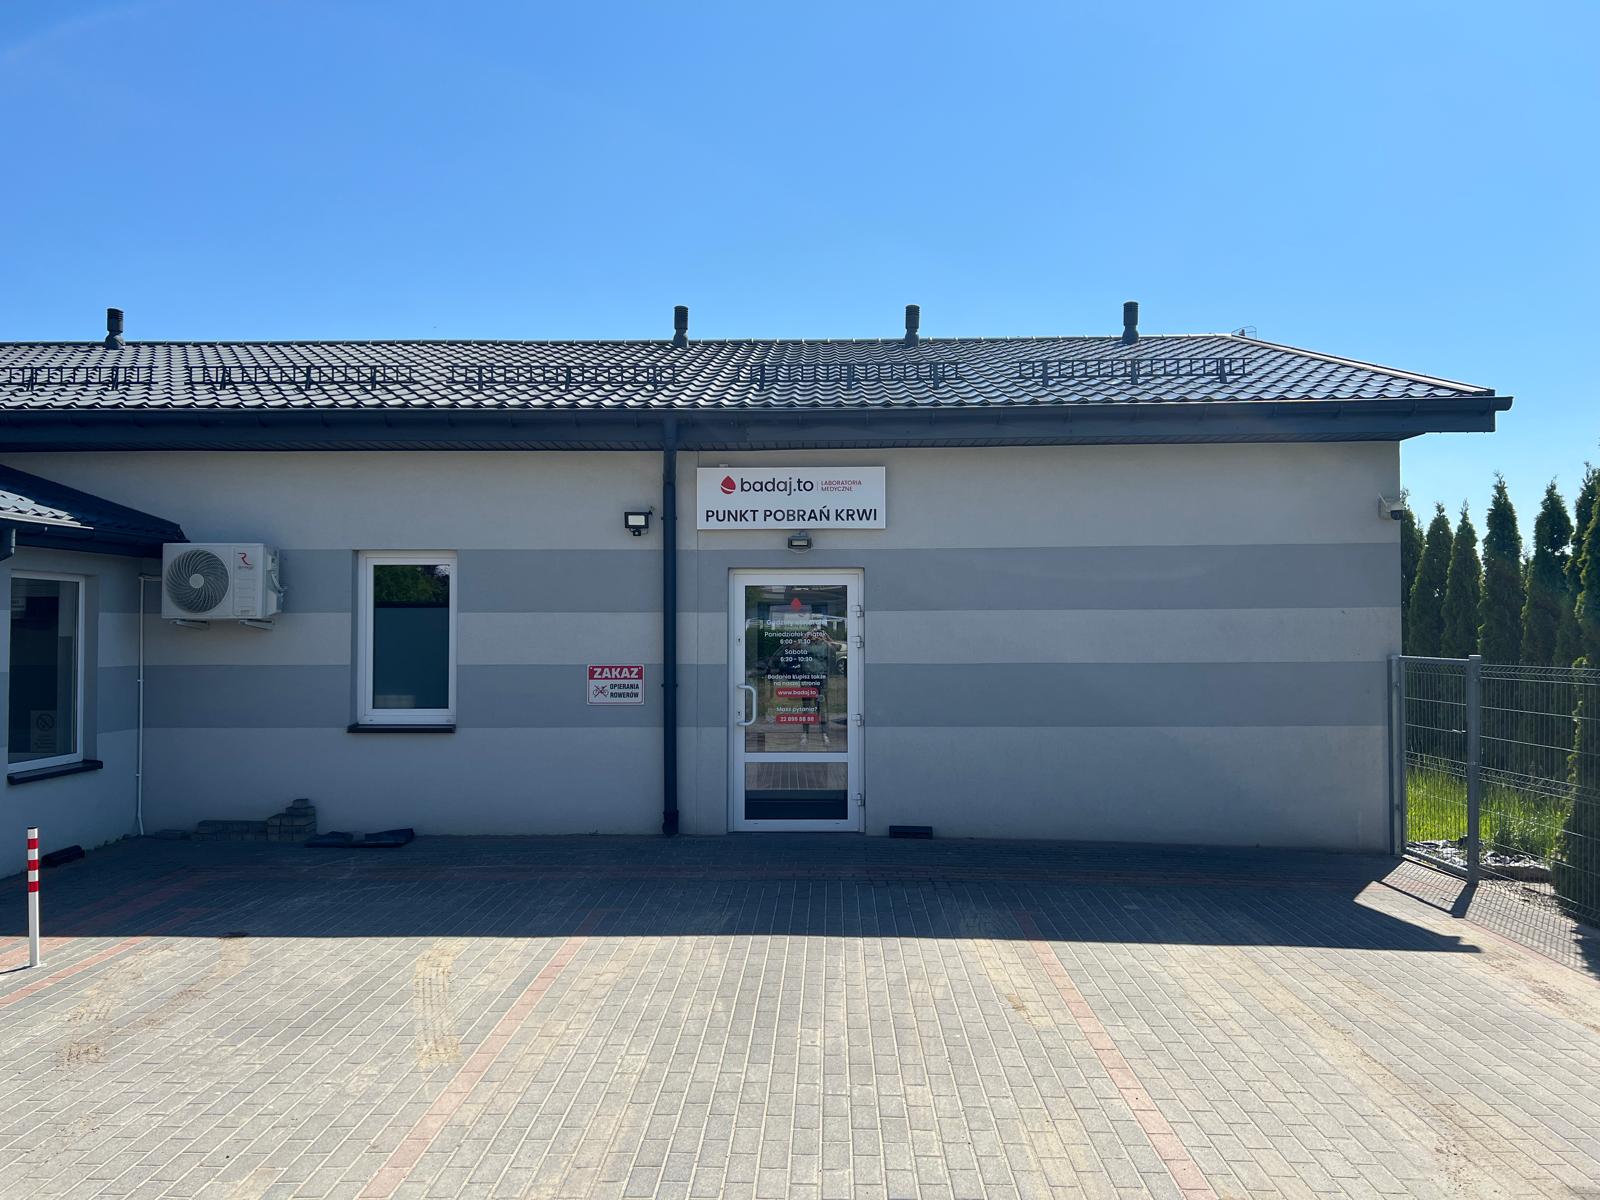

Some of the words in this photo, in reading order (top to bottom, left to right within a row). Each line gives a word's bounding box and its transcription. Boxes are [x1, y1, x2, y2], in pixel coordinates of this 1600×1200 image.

[740, 477, 814, 496] badaj.to
[705, 509, 759, 522] PUNKT
[763, 505, 830, 522] POBRAŃ
[835, 508, 877, 521] KRWI
[593, 667, 639, 679] ZAKAZ
[610, 691, 639, 699] ROWERÓW
